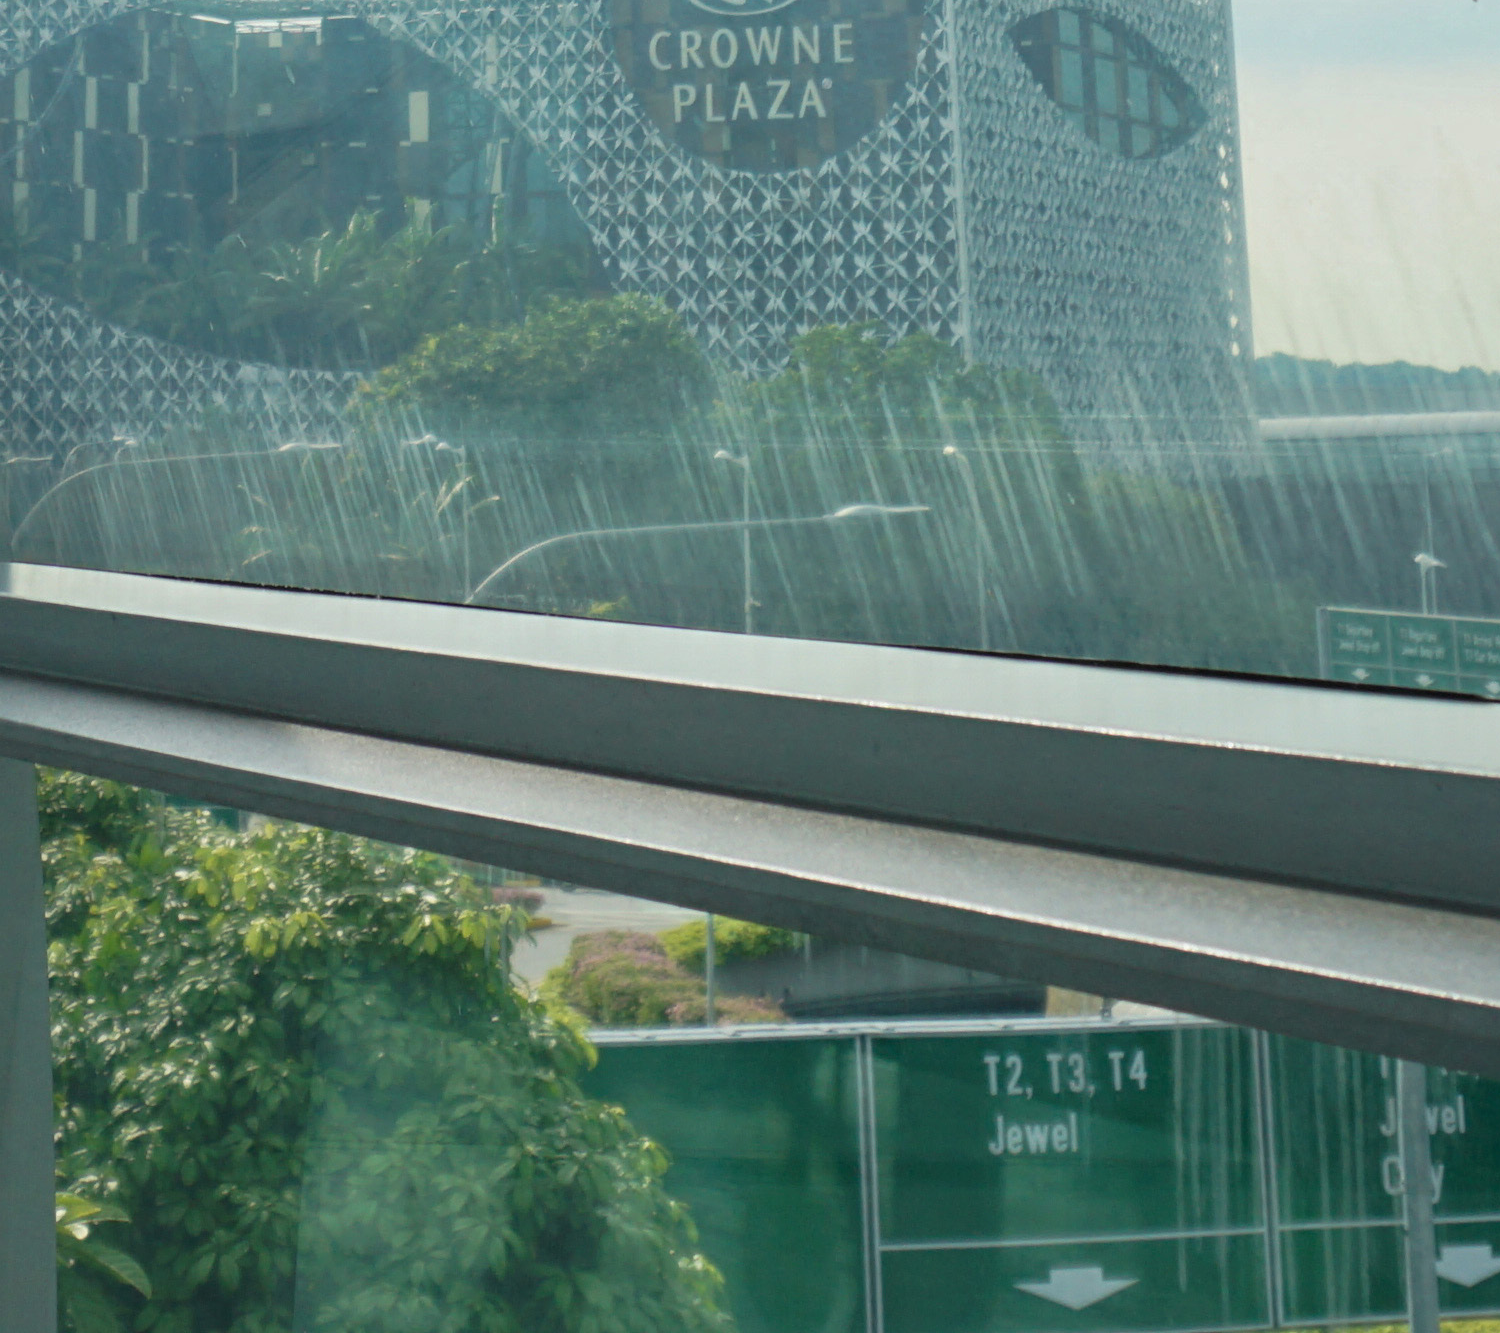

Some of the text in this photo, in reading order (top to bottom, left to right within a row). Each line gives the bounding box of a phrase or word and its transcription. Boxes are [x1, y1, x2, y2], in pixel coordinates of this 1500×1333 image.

[648, 23, 855, 71] CROWNE
[672, 78, 828, 123] PLAZA
[983, 1049, 1148, 1100] T2, T3, T4
[987, 1111, 1079, 1156] Jewel
